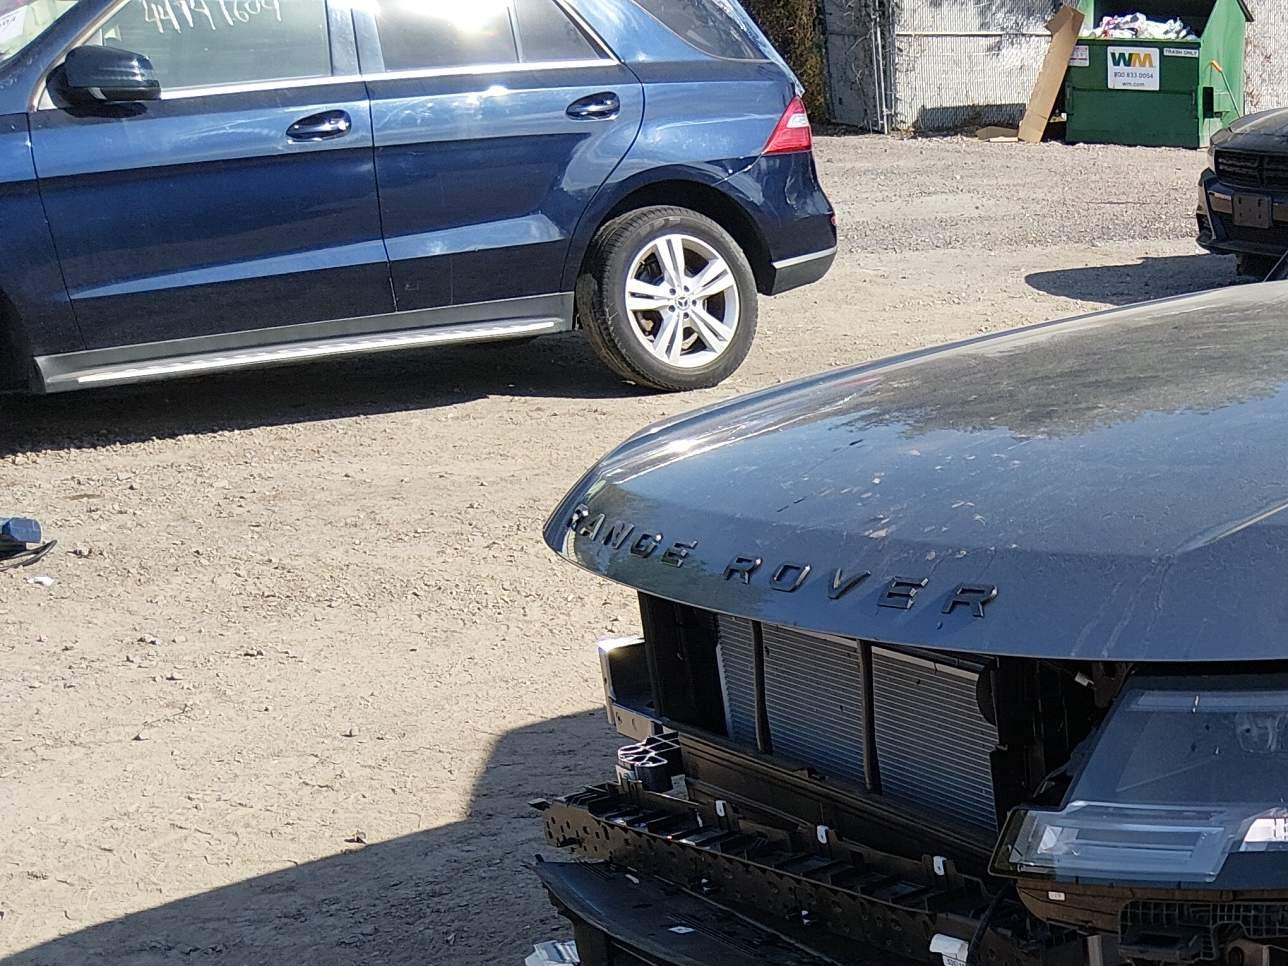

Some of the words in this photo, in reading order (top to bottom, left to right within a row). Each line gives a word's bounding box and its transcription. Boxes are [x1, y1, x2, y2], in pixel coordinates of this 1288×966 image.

[1110, 52, 1154, 68] WM
[568, 503, 697, 568] RANGE
[722, 554, 999, 618] ROVER
